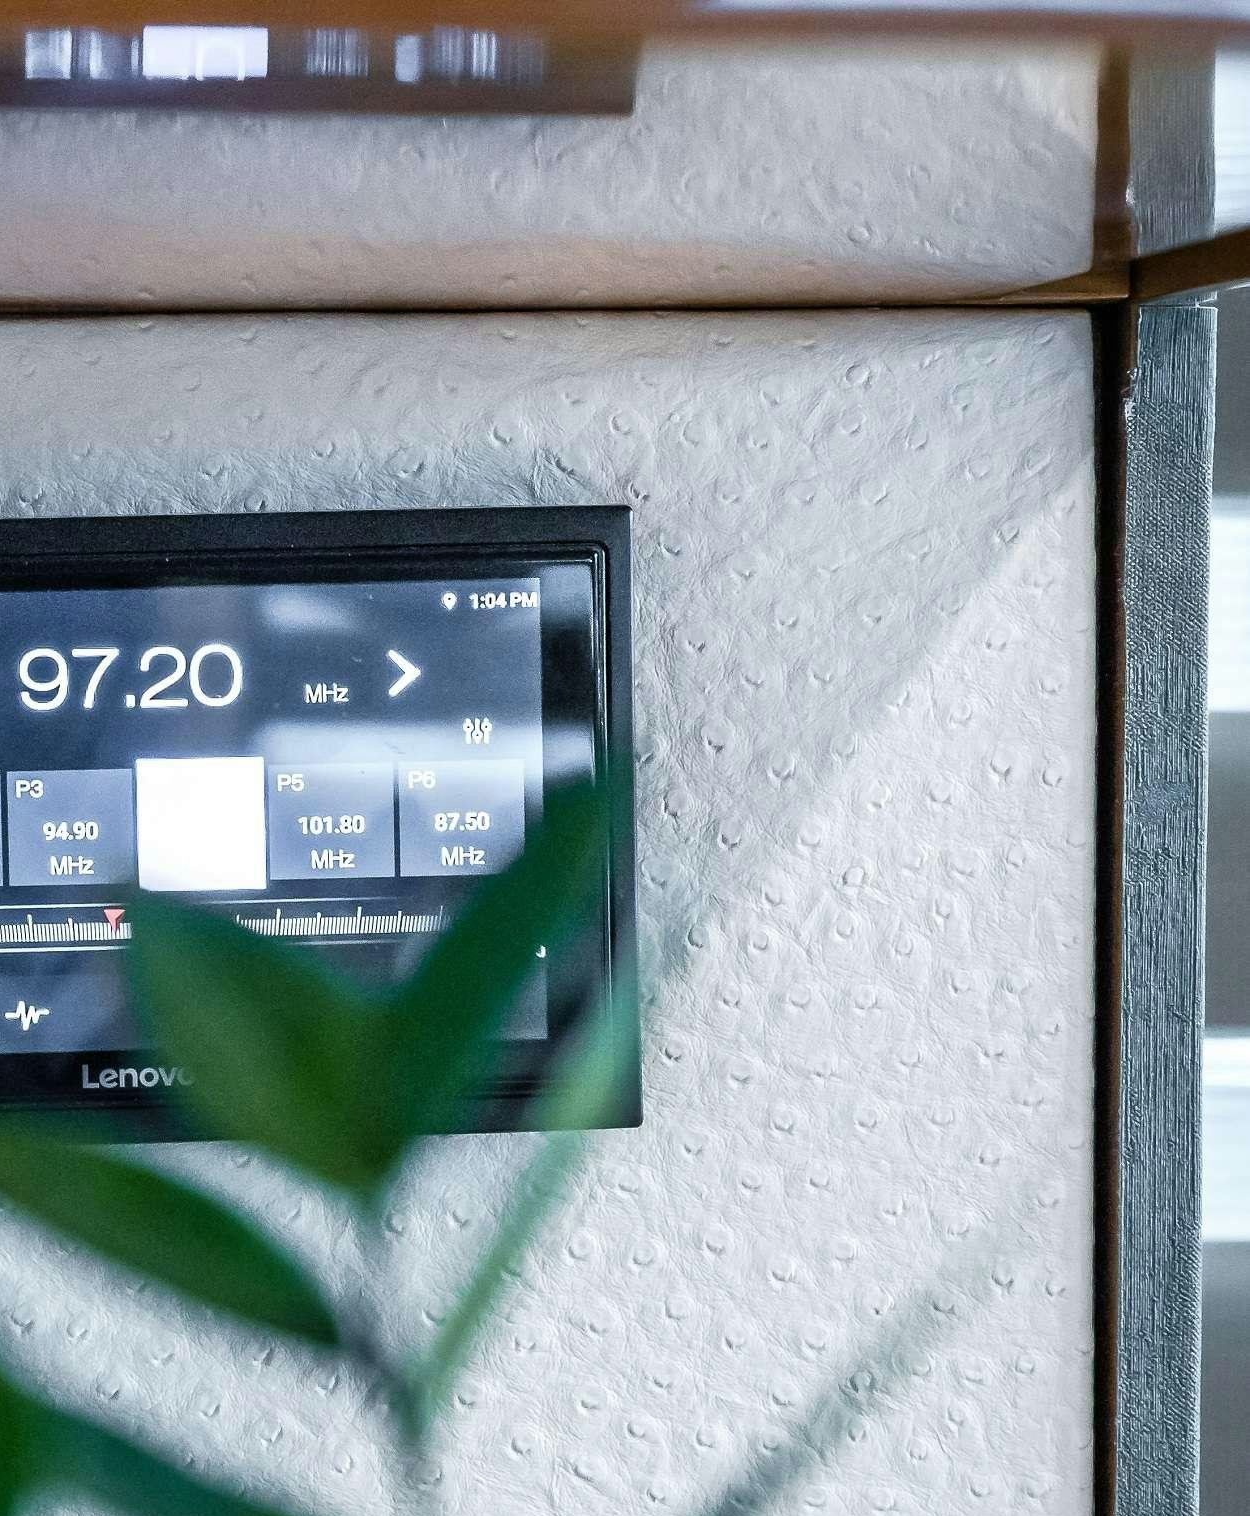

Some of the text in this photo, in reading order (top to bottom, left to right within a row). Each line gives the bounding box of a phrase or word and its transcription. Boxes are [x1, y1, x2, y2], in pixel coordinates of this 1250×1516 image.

[469, 591, 538, 609] 1:04 PM
[18, 642, 244, 711] 97.20
[305, 682, 350, 704] MHz
[15, 779, 44, 800] P3
[277, 773, 305, 792] P5
[408, 771, 437, 789] P6
[42, 821, 99, 841] 94.90
[298, 814, 366, 835] 101.80
[434, 811, 490, 832] 87.50
[50, 855, 95, 876] MHz
[311, 849, 355, 870] MHz
[441, 845, 486, 866] MHz
